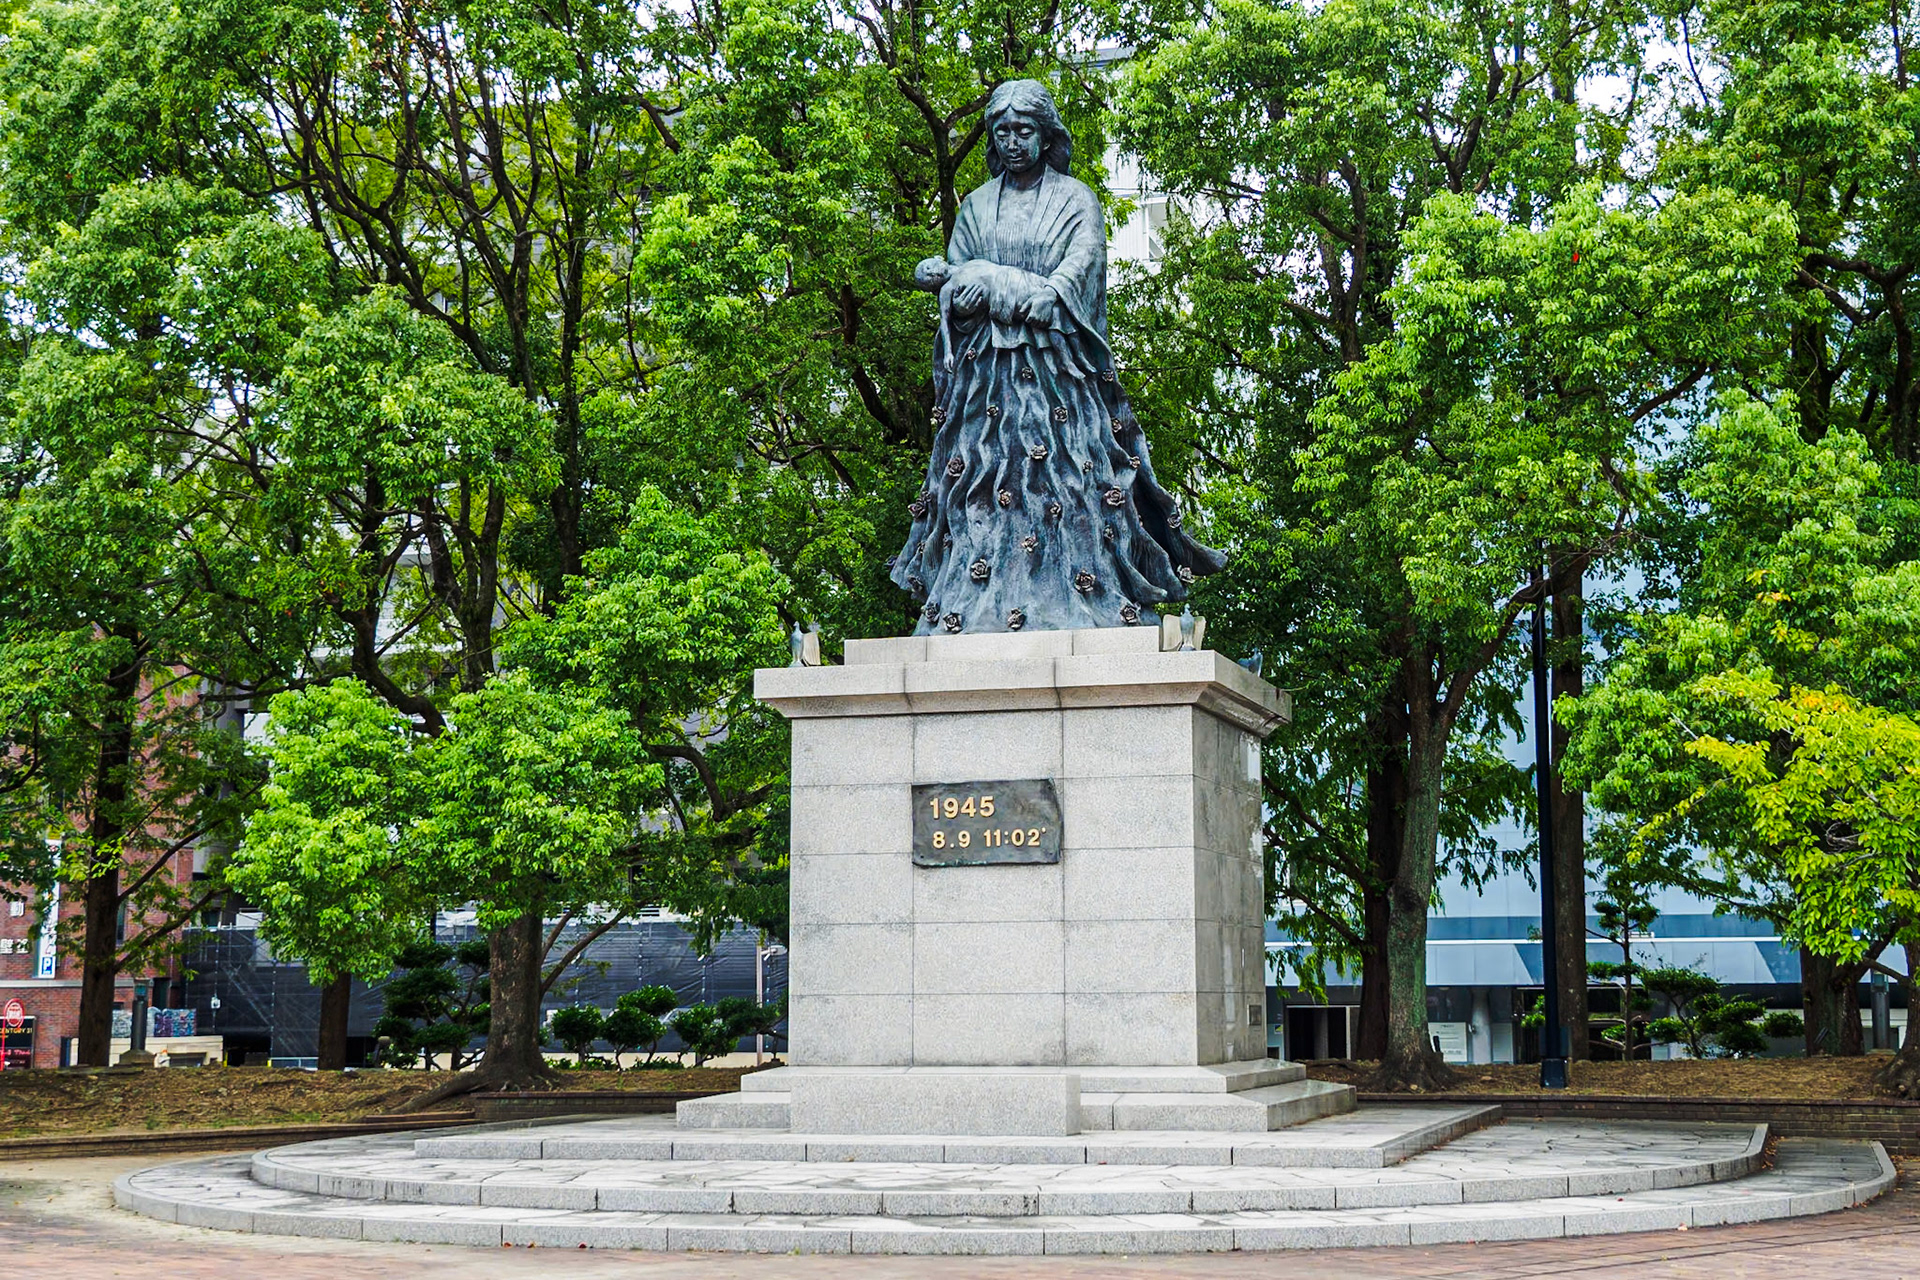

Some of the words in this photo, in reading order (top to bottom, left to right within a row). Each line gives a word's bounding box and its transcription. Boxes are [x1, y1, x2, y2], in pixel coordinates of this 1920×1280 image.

[930, 795, 995, 819] 1945
[932, 830, 971, 849] 8.9
[43, 958, 52, 970] P
